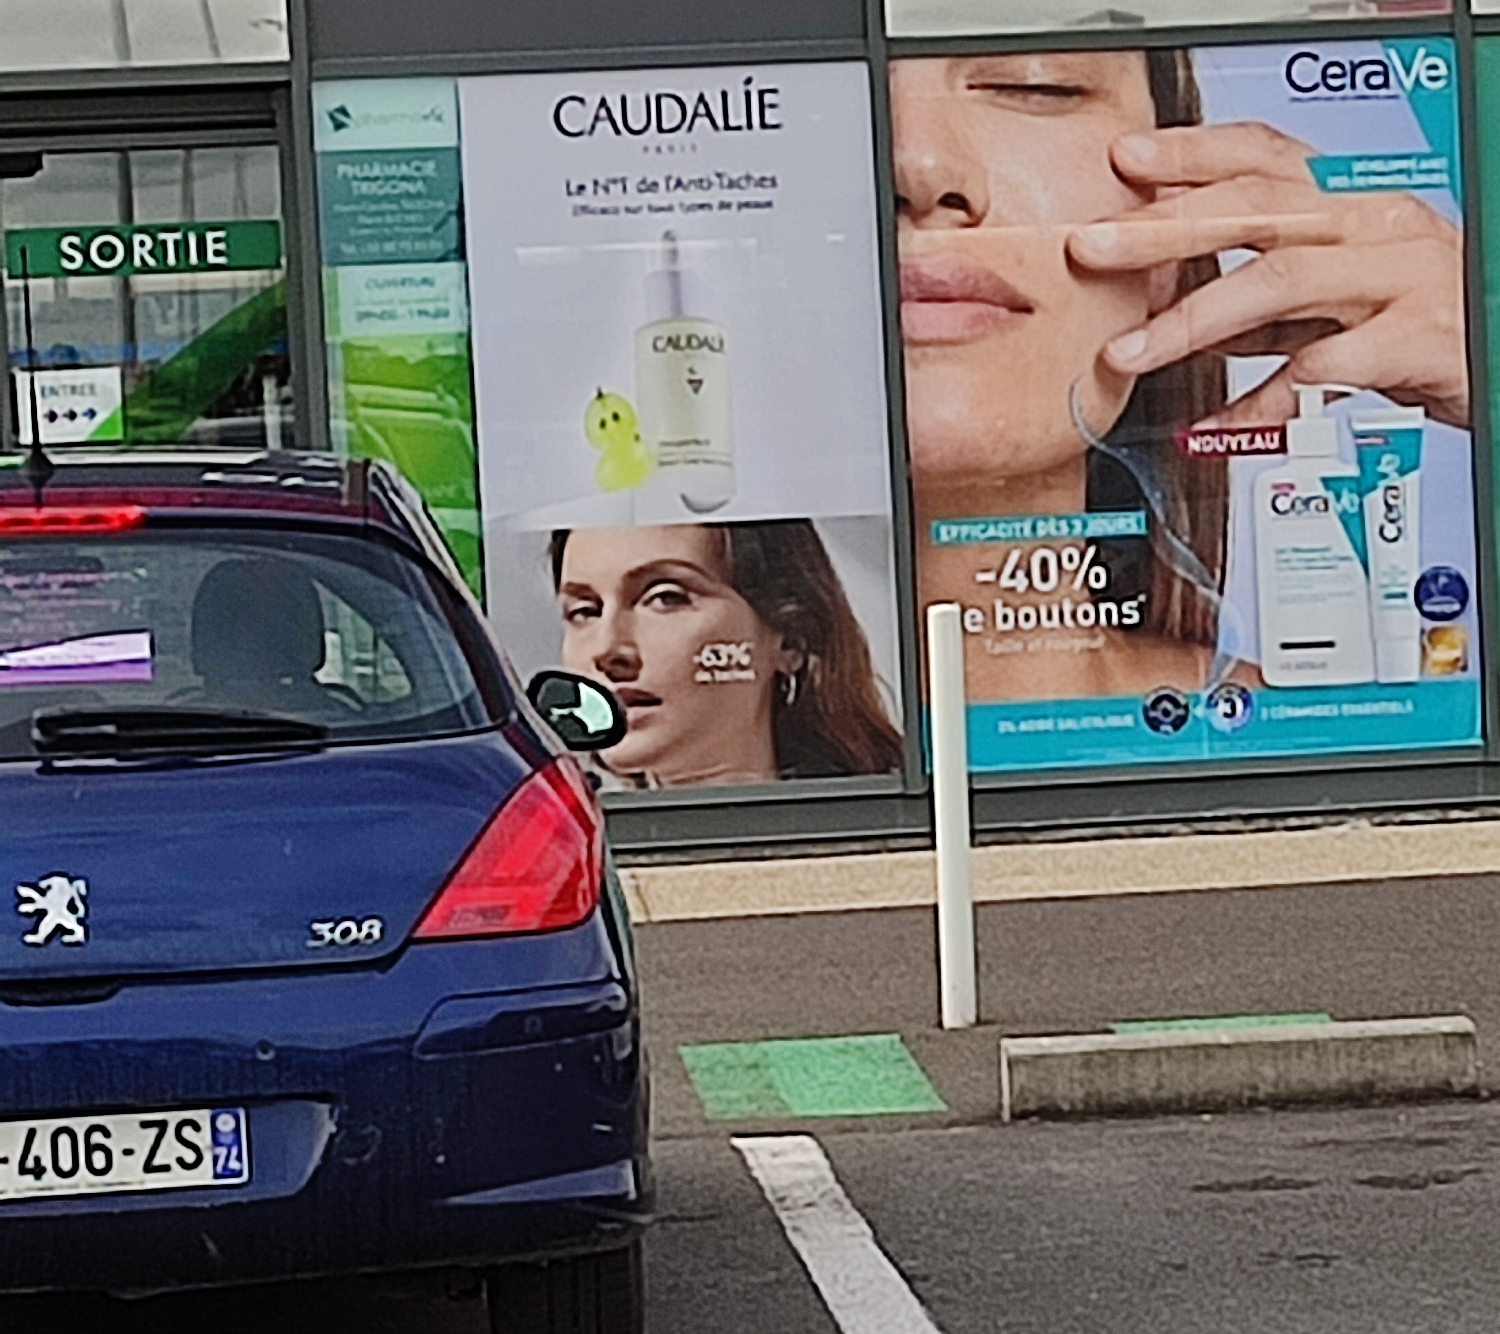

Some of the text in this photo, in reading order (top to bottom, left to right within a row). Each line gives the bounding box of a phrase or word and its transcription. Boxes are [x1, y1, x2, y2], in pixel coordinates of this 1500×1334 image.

[1286, 46, 1449, 93] CeraVe
[566, 178, 586, 197] Le
[636, 175, 659, 195] de
[59, 229, 228, 271] SORTIE
[1187, 430, 1281, 455] NOUVEAU
[975, 543, 1108, 593] -40%
[692, 642, 753, 668] -63%
[306, 918, 383, 948] 308
